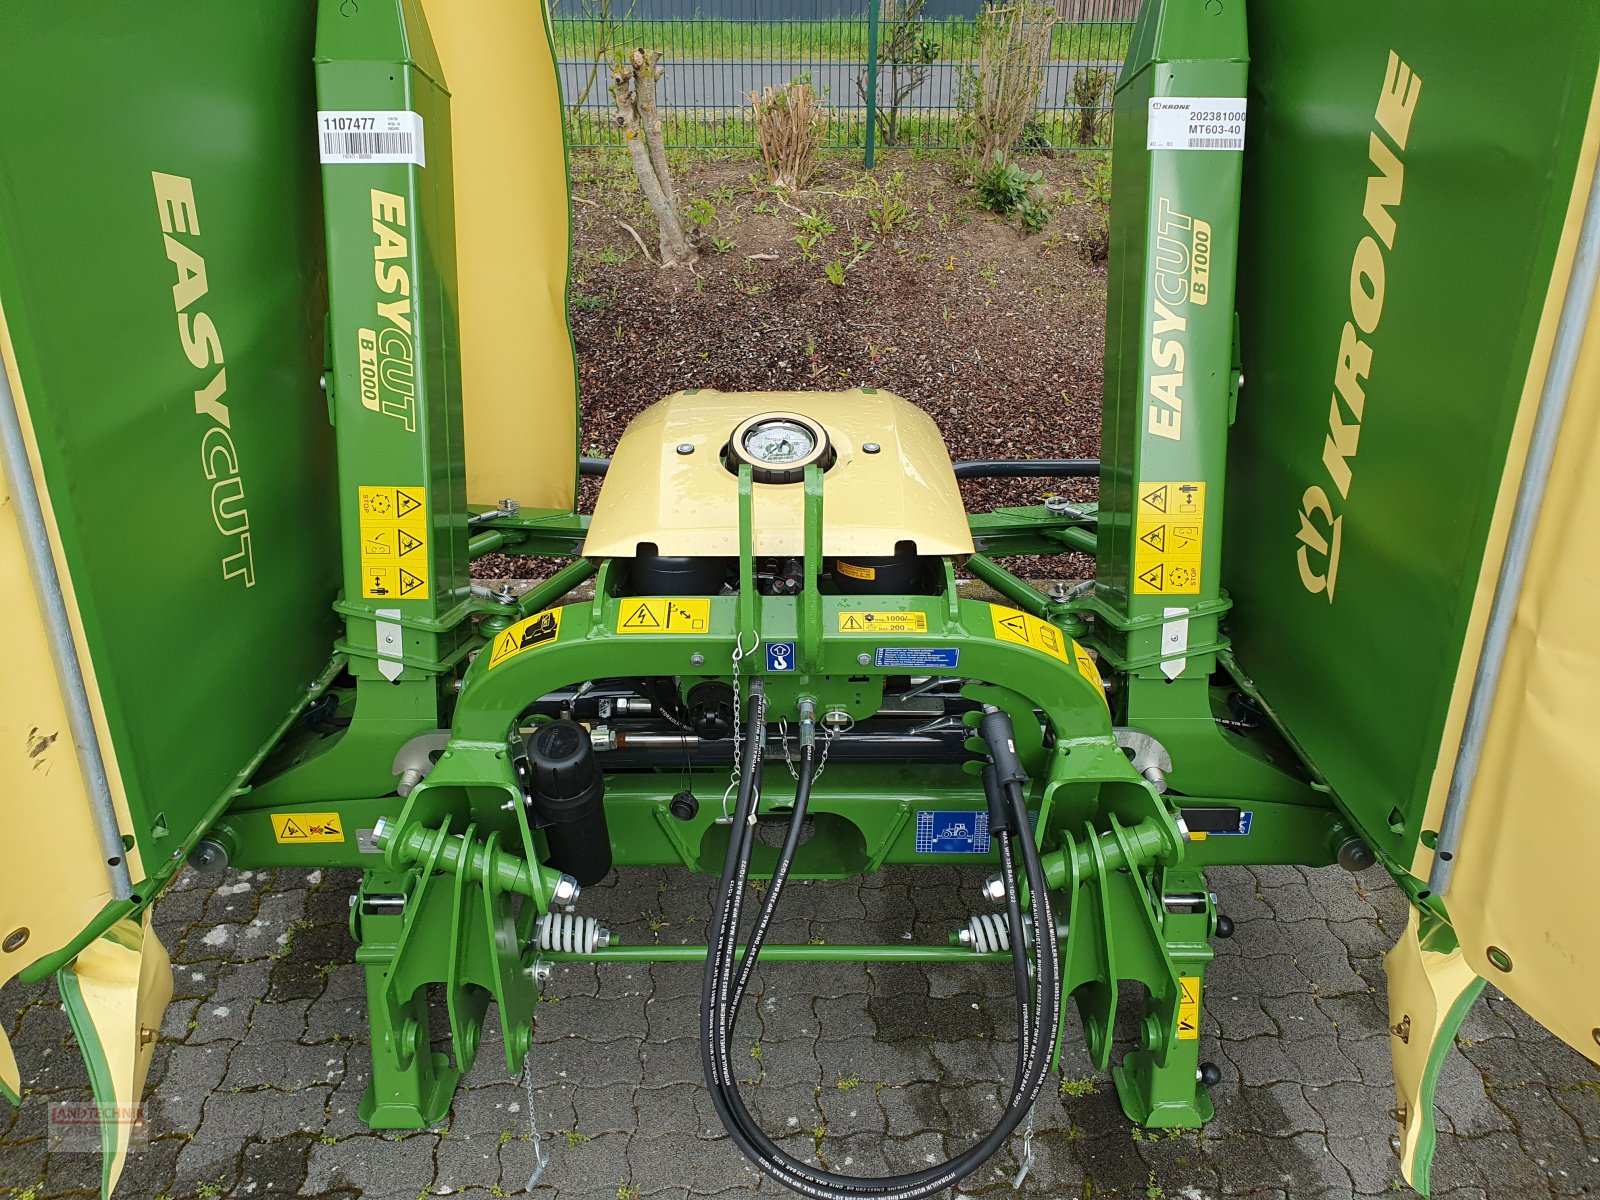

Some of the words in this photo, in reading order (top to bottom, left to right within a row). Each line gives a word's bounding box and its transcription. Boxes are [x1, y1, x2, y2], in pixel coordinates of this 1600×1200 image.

[324, 118, 375, 130] 1107477
[1188, 124, 1241, 134] MT603-40
[1194, 230, 1208, 274] 1000
[1322, 50, 1422, 500] KRONE
[1193, 282, 1205, 294] B
[370, 188, 416, 432] EASYCUT
[1148, 196, 1192, 441] EASYCUT
[361, 338, 374, 350] B
[151, 170, 256, 588] EASYCUT
[362, 358, 377, 400] 1000
[774, 879, 782, 892] BAR
[769, 892, 778, 903] 330
[766, 903, 773, 913] WP
[1030, 890, 1039, 927] HYDRAULIK
[1049, 928, 1058, 957] MUELLER
[721, 1054, 731, 1086] HYDRAULIK
[732, 907, 738, 918] WP
[1027, 1059, 1034, 1069] WP
[1045, 1054, 1052, 1063] WP
[1019, 1078, 1028, 1091] BAR
[1037, 1073, 1046, 1085] BAR
[772, 1168, 784, 1180] BAR
[786, 1164, 797, 1174] BAR
[783, 1175, 793, 1184] 330
[792, 1180, 802, 1189] WP
[926, 1172, 956, 1192] HYDRAULIK
[817, 1190, 832, 1198] DN10
[899, 1186, 926, 1198] MUELLER
